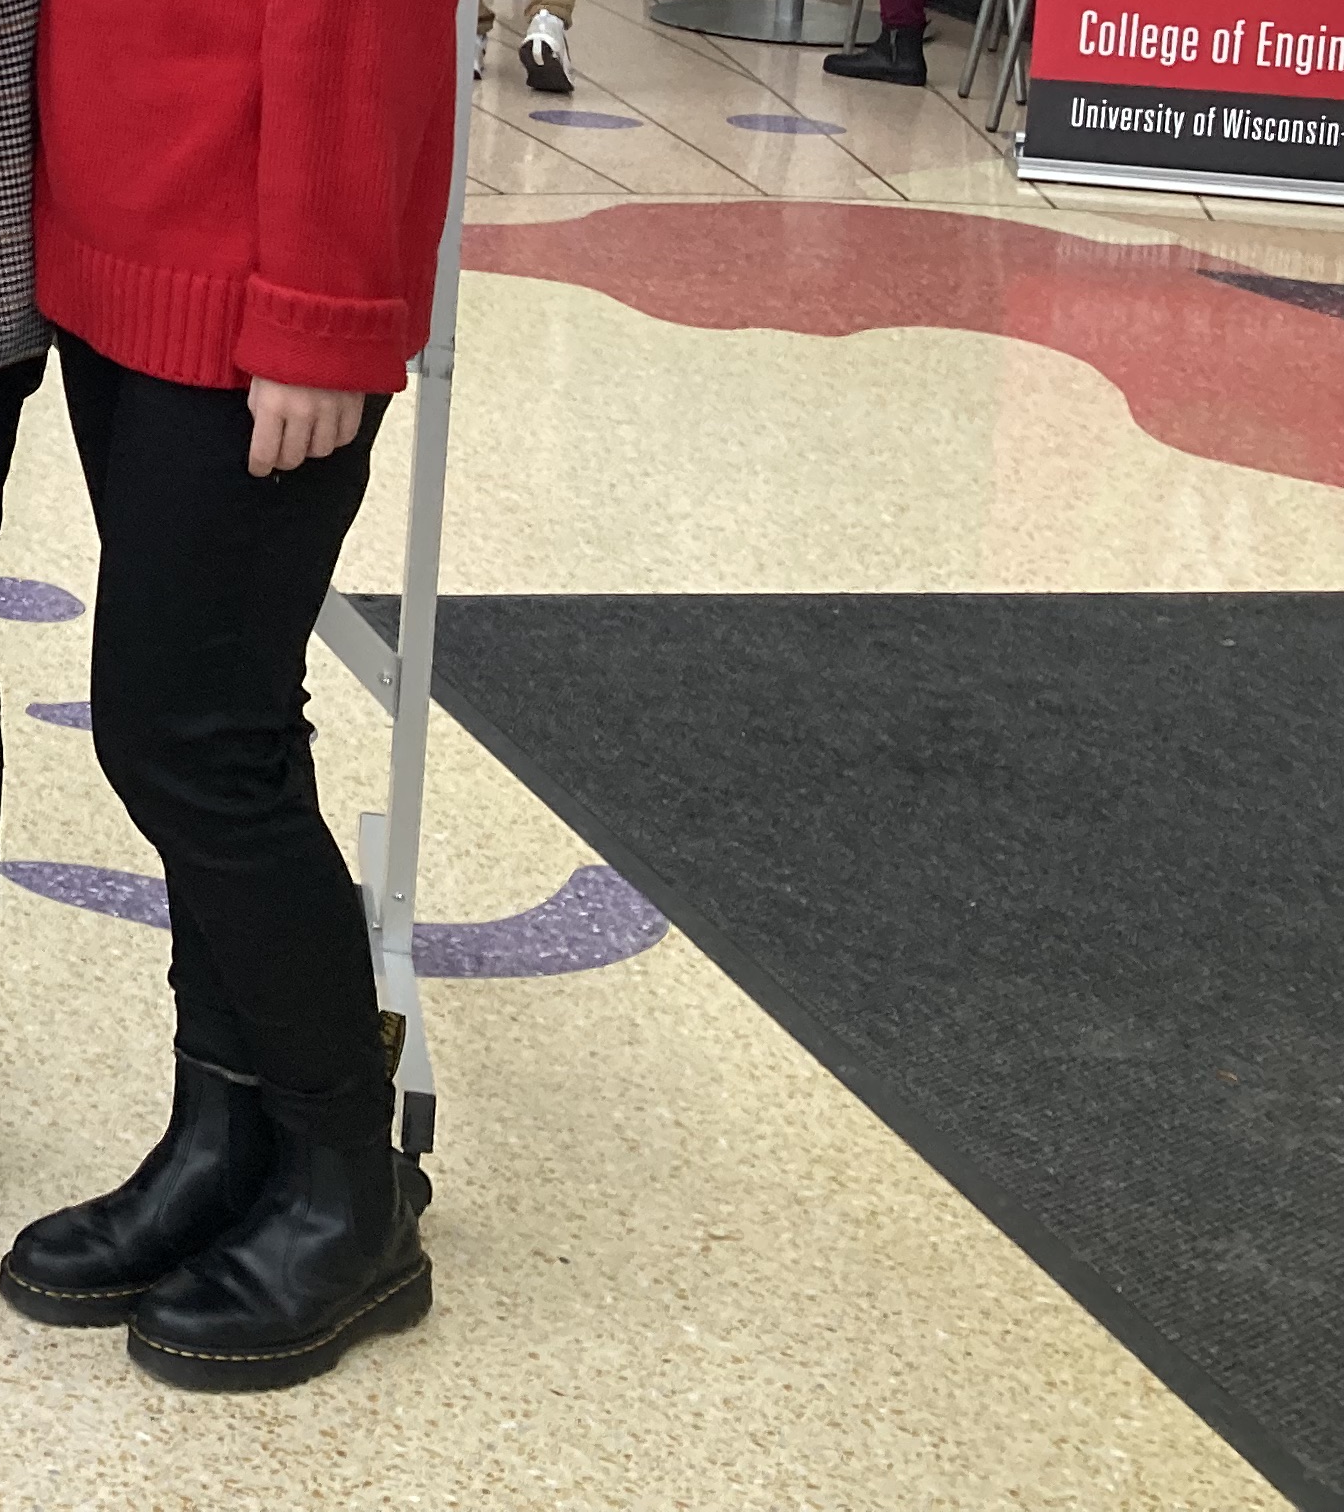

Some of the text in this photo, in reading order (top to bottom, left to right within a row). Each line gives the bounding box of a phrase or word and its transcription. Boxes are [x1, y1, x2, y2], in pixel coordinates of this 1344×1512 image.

[1079, 9, 1344, 76] College of Engin
[1071, 97, 1344, 146] University of Wisconsin-
